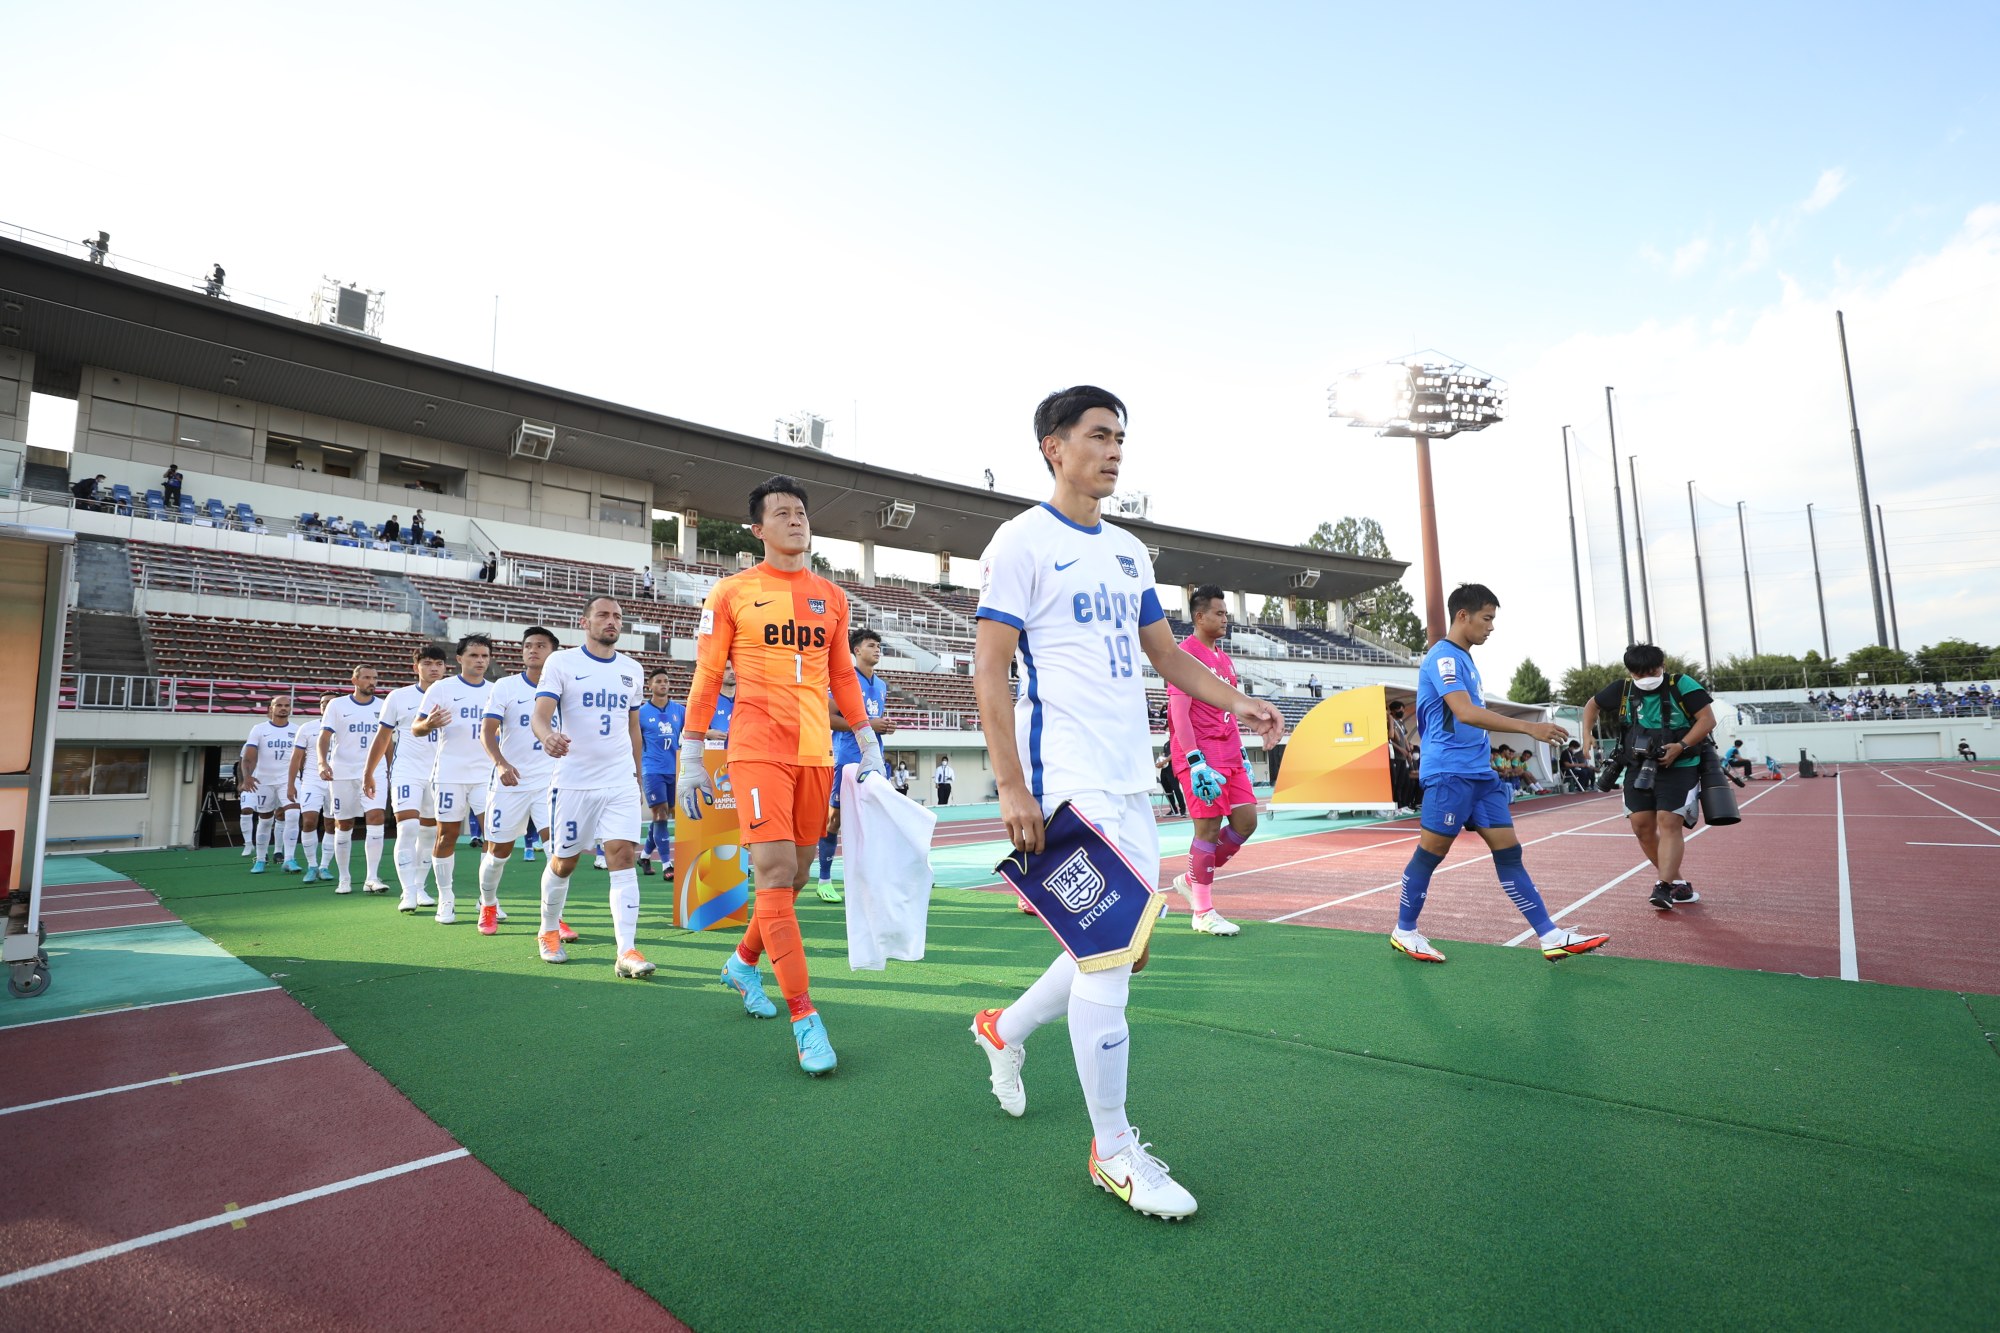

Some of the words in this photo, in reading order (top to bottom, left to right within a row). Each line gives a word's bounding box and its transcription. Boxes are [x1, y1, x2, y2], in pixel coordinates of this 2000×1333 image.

[1072, 582, 1139, 629] edps
[764, 619, 826, 651] edps
[1104, 635, 1133, 678] 19
[793, 653, 803, 684] 1
[582, 689, 629, 711] edps
[349, 721, 378, 734] edps
[599, 714, 611, 736] 3
[267, 738, 293, 749] edps
[360, 736, 367, 748] 9
[428, 728, 438, 742] 18
[664, 738, 672, 750] 17
[274, 750, 285, 761] 17
[305, 792, 312, 803] 7
[397, 784, 410, 799] 18
[257, 795, 267, 806] 17
[334, 798, 340, 810] 9
[439, 792, 454, 809] 15
[750, 786, 762, 820] 1
[493, 809, 501, 828] 2
[566, 821, 577, 841] 3
[1078, 890, 1120, 930] KITCHEE
